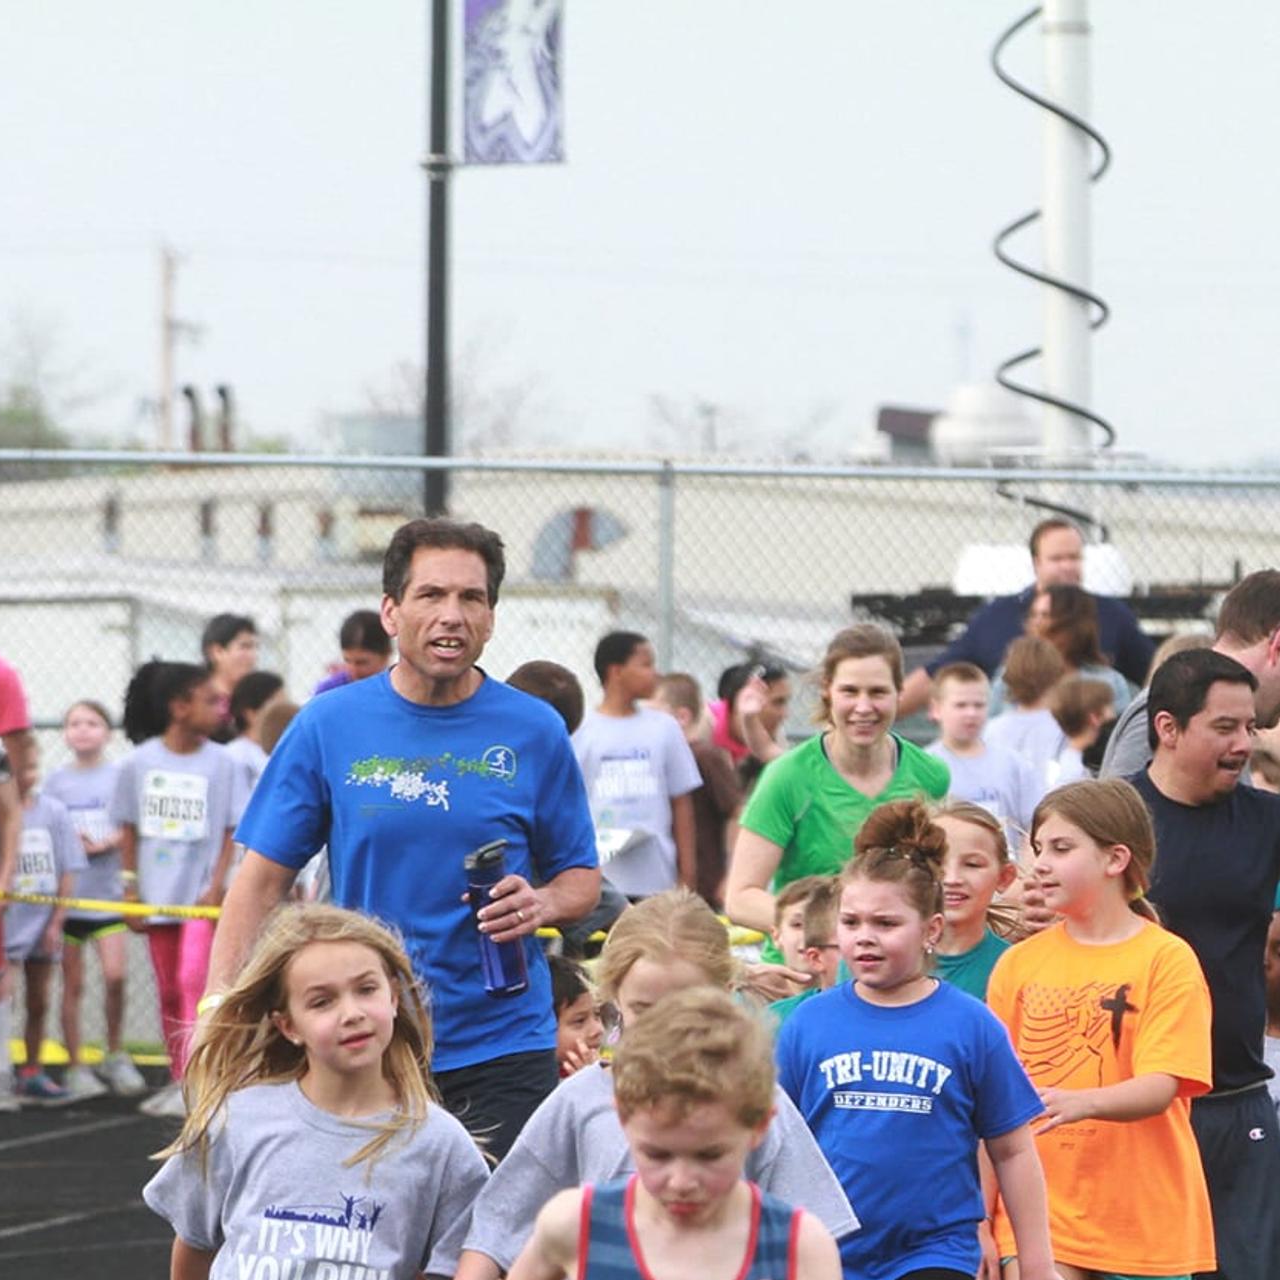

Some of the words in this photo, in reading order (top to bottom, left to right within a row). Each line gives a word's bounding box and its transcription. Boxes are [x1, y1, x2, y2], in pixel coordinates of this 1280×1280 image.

[819, 1051, 952, 1095] TRI-UNITY
[834, 1094, 933, 1111] DEFENDERS
[257, 1218, 308, 1256] IT'S
[314, 1226, 373, 1265] WHY
